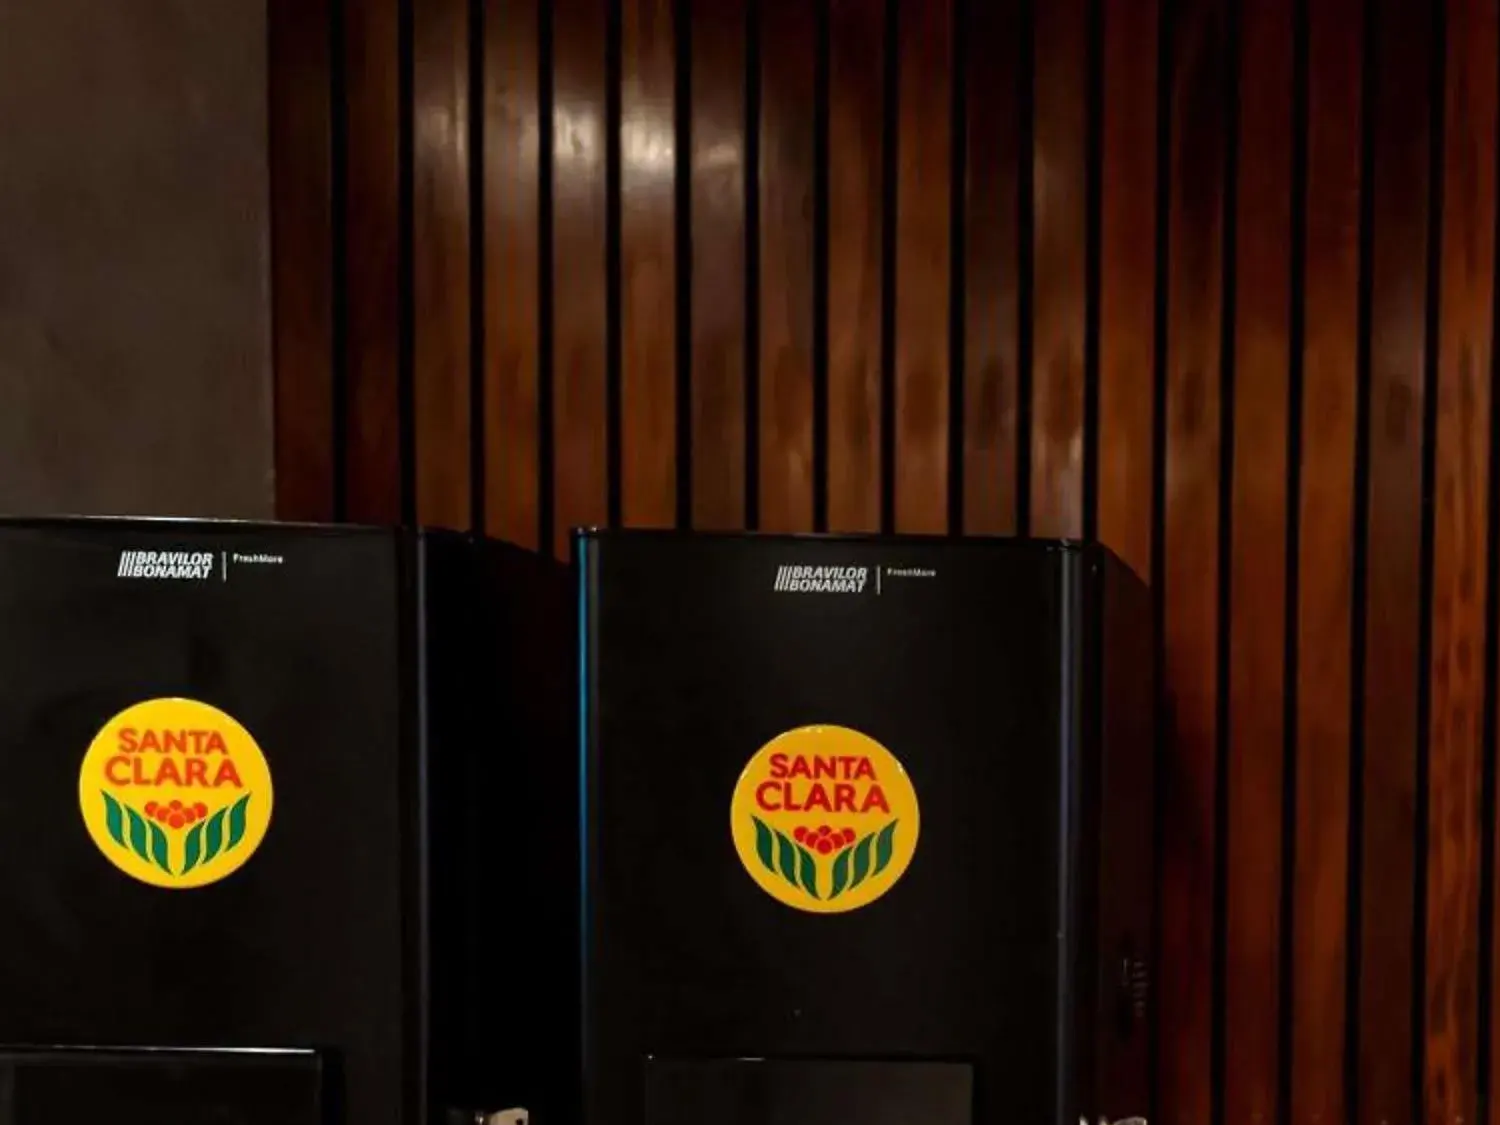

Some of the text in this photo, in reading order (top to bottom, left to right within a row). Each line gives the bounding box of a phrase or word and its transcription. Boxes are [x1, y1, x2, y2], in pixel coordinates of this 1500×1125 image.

[135, 551, 213, 566] BRAVILOR
[133, 565, 211, 579] BONAMAT
[792, 565, 868, 580] BRAVILOR
[789, 579, 866, 593] BONAMAT
[118, 727, 229, 755] SANTA
[104, 755, 243, 788] CLARA
[769, 753, 877, 780] SANTA
[755, 780, 891, 813] CLARA
